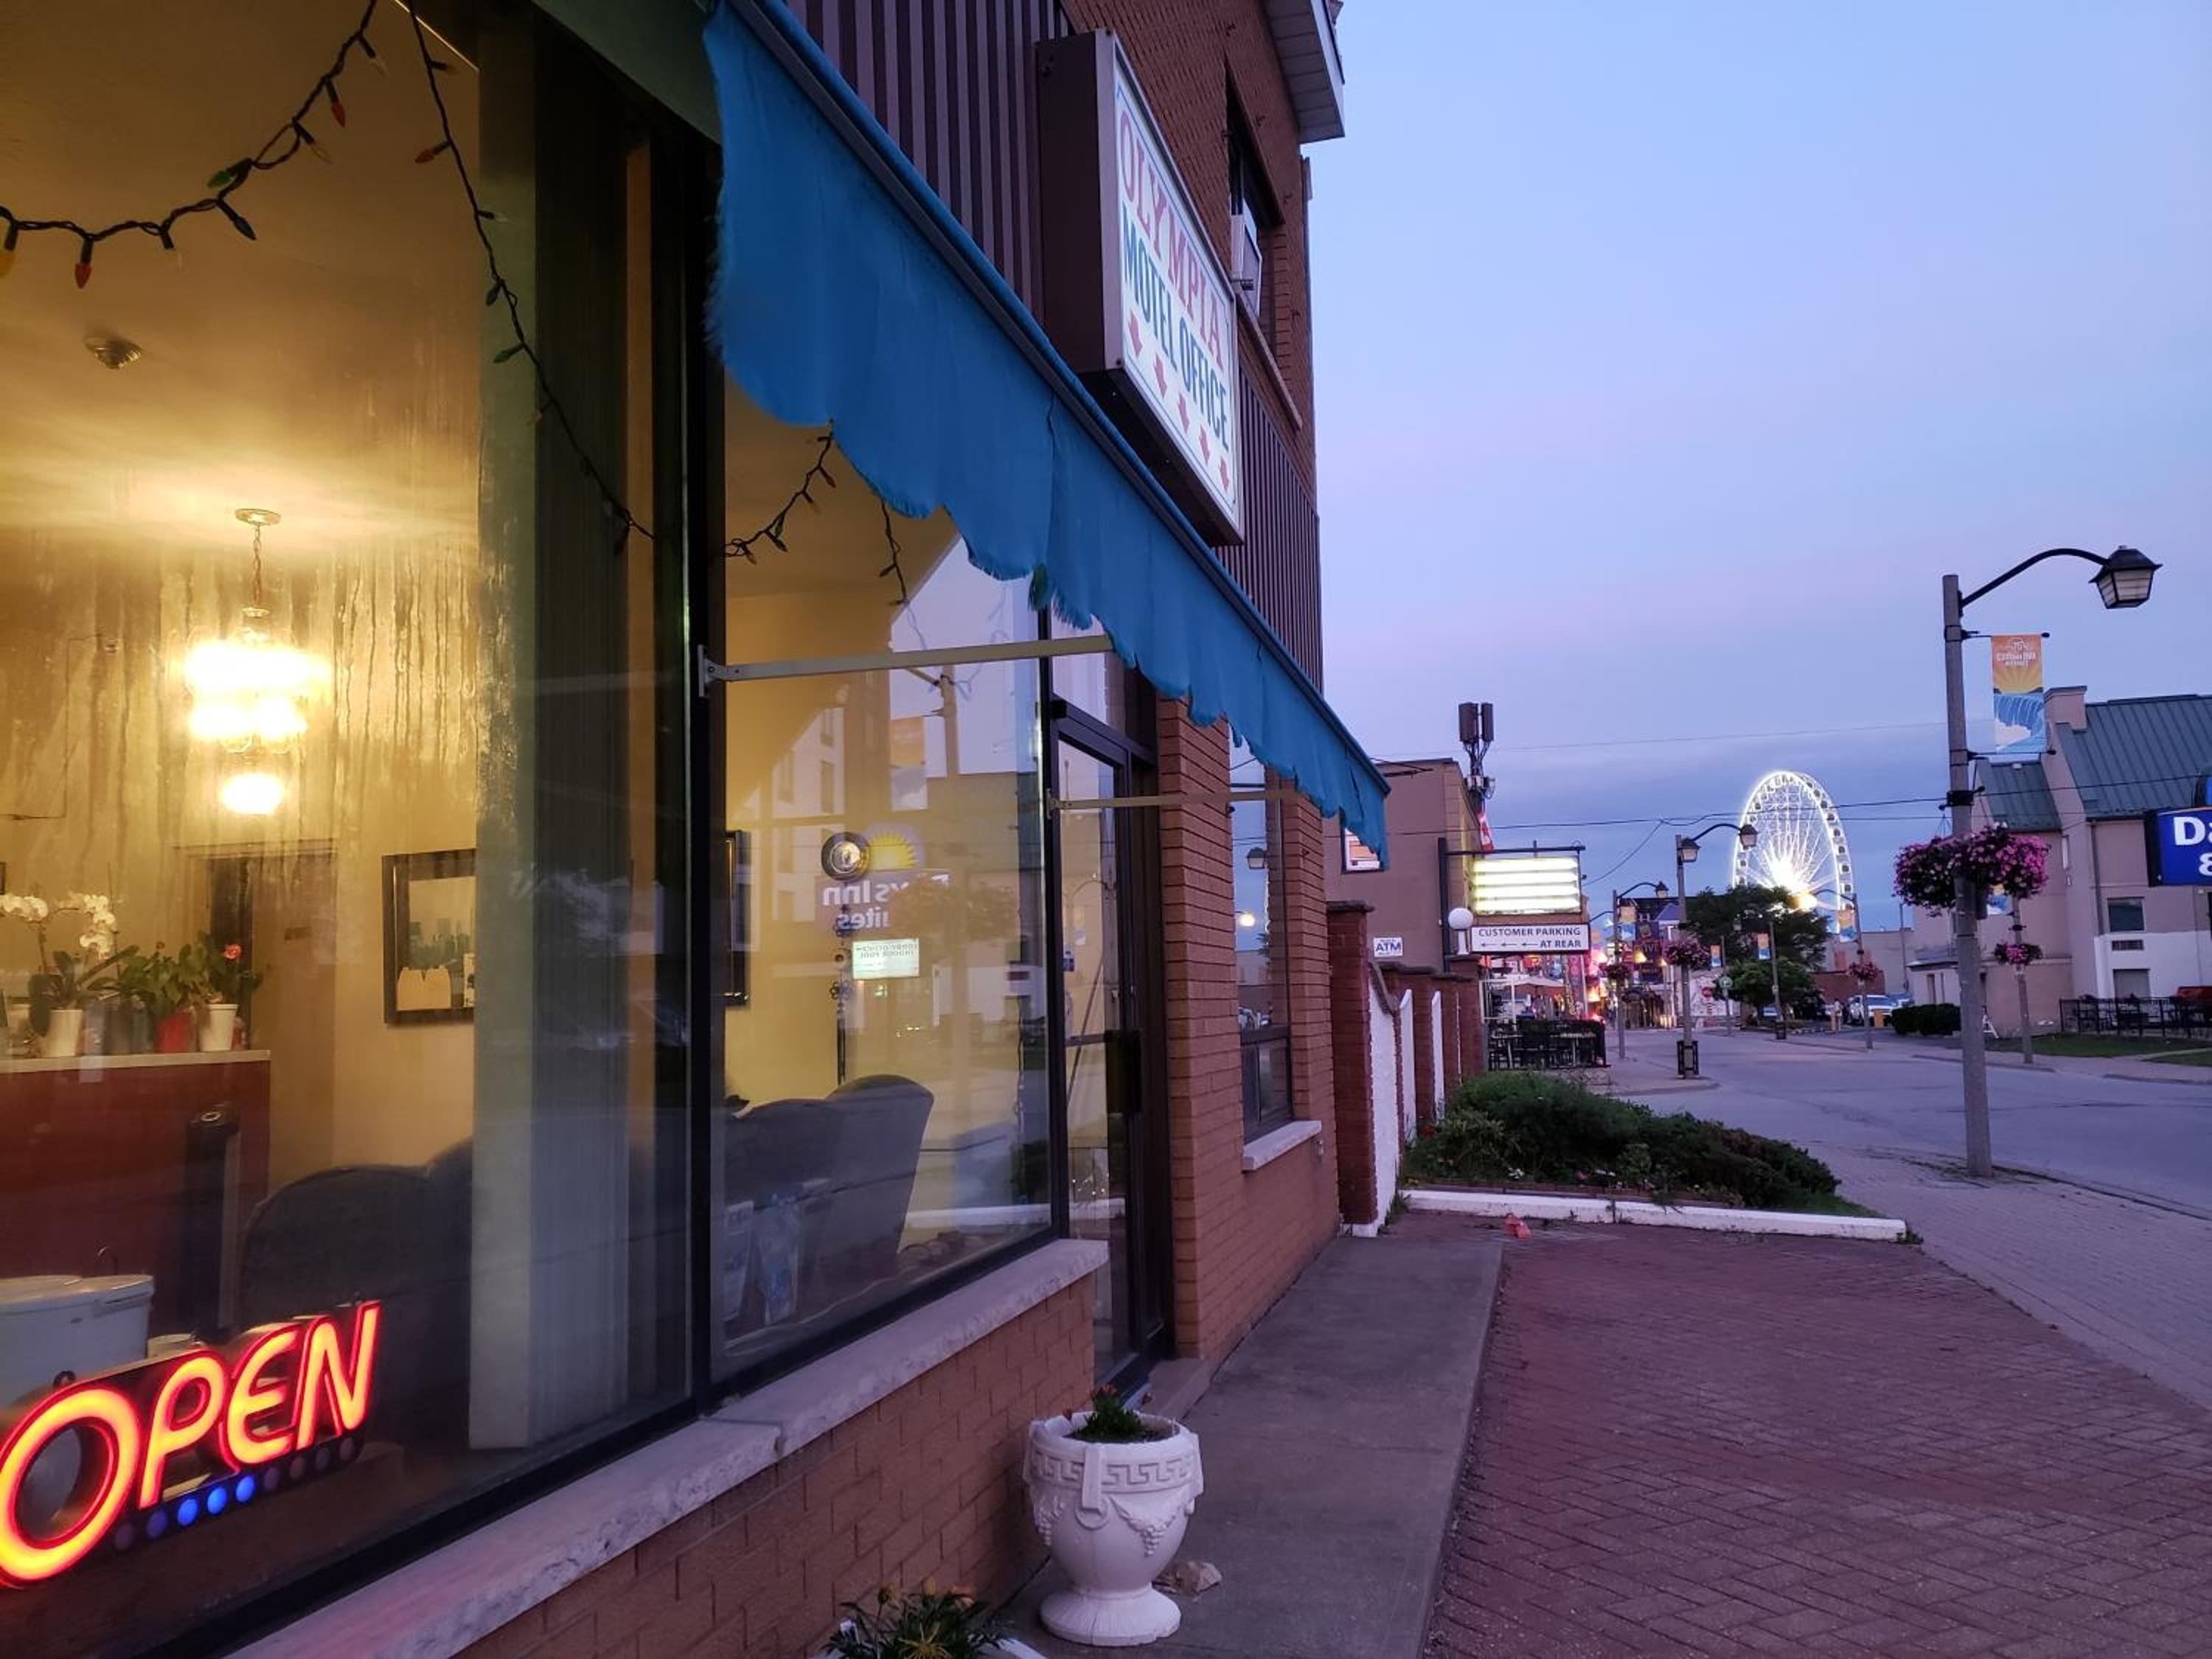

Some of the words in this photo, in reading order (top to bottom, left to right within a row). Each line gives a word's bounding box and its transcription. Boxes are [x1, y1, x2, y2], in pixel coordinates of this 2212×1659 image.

[1120, 111, 1225, 374] OLYMPIA
[1122, 200, 1178, 373] MOTEL
[1180, 316, 1229, 452] OFFICE
[1375, 942, 1402, 952] ATM
[1478, 928, 1533, 937] CUSTOMER
[1536, 927, 1582, 936] PARKING
[1540, 940, 1552, 948] AT
[1554, 939, 1582, 948] REAR
[0, 1300, 381, 1582] OPEN
